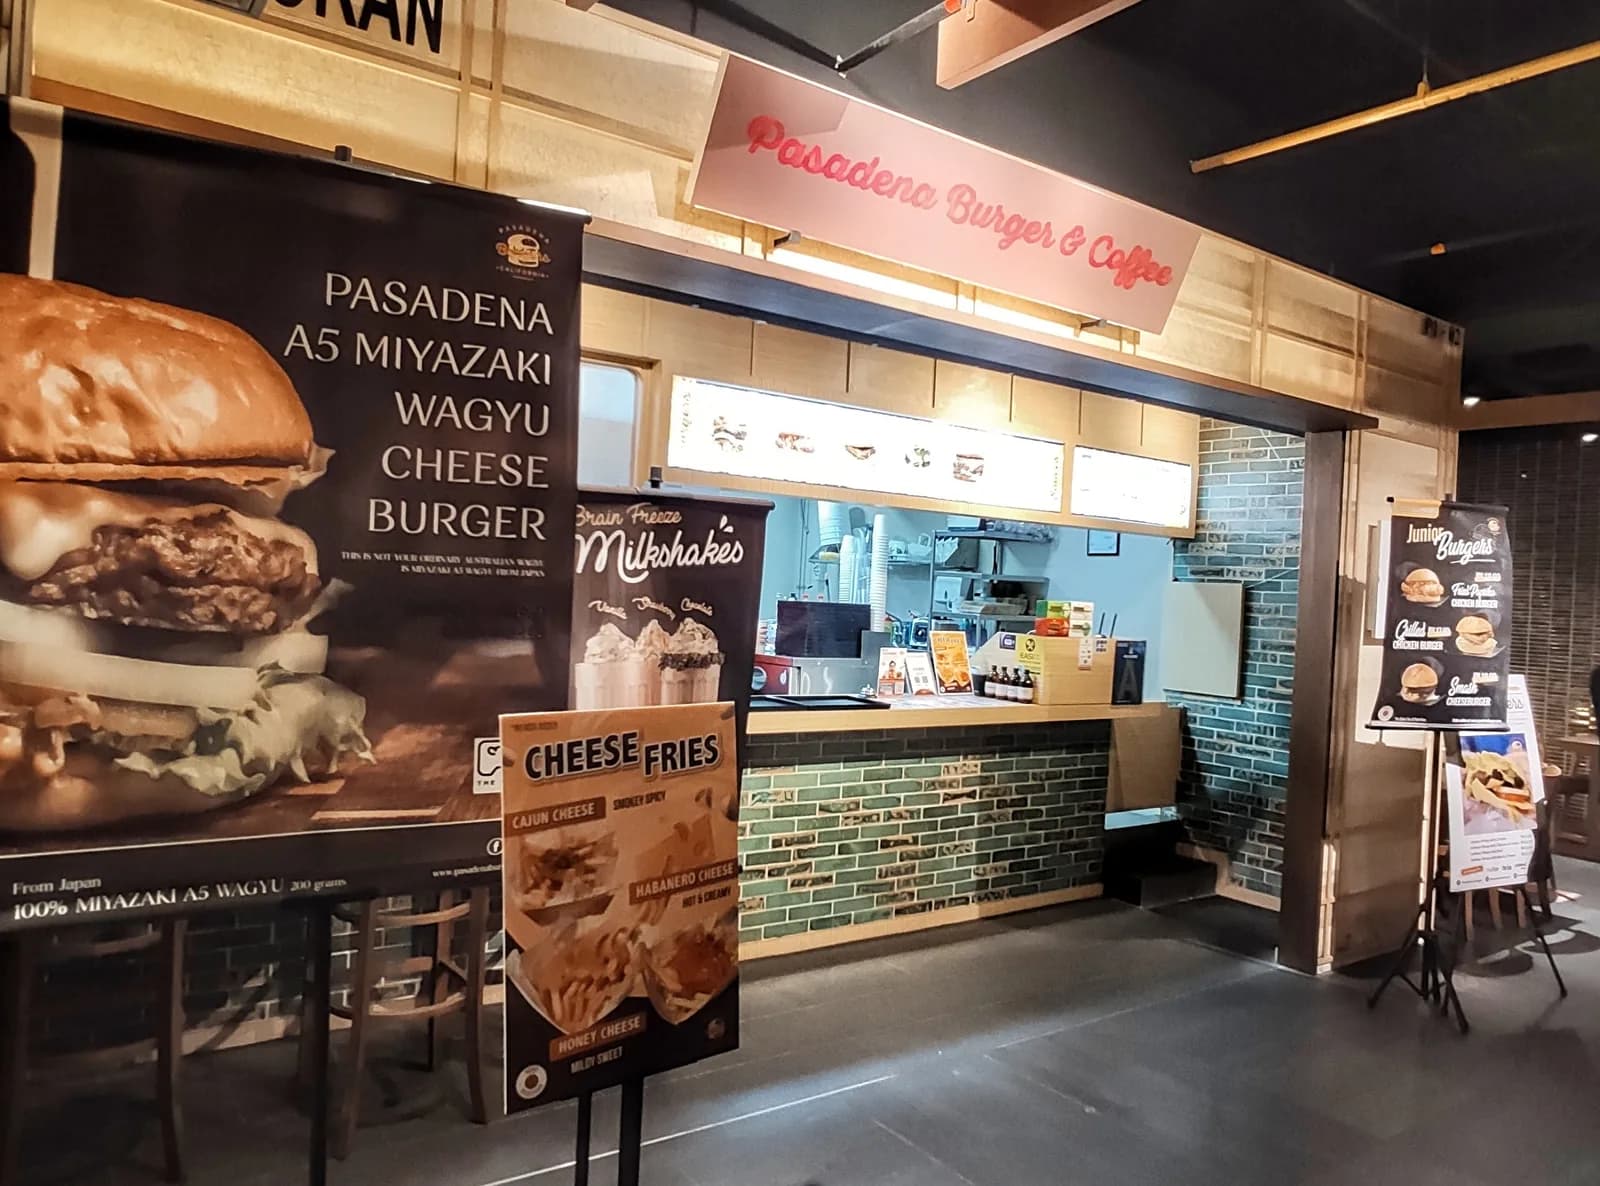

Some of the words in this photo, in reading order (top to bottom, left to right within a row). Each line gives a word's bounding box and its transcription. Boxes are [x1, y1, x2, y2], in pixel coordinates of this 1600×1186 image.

[747, 115, 938, 210] Pasadena
[946, 183, 1056, 250] Burger
[1060, 225, 1086, 256] &
[1088, 234, 1174, 290] Coffee
[325, 272, 554, 335] PASADENA
[284, 324, 341, 363] A5
[355, 332, 550, 385] MIYAZAKI
[395, 391, 550, 437] WAGYU
[381, 445, 549, 489] CHEESE
[368, 498, 547, 541] BURGER
[576, 504, 623, 526] Brain
[626, 502, 682, 524] Freeze
[575, 528, 744, 584] Milkshakes
[1406, 523, 1444, 544] Junior
[1436, 530, 1494, 565] Burgers
[525, 732, 638, 779] CHEESE
[645, 735, 720, 776] FRIES
[512, 811, 548, 829] CAJUN
[552, 802, 595, 822] CHEESE
[13, 881, 54, 895] From
[58, 876, 101, 893] Japan
[14, 899, 68, 920] 100%
[75, 888, 177, 914] MIYAZAKI
[183, 885, 209, 903] A5
[216, 878, 284, 898] WAGYU
[314, 877, 347, 892] grams
[636, 872, 696, 898] HABANERO
[698, 863, 734, 882] CHEESE
[559, 1032, 597, 1053] HONEY
[600, 1016, 641, 1040] CHEESE
